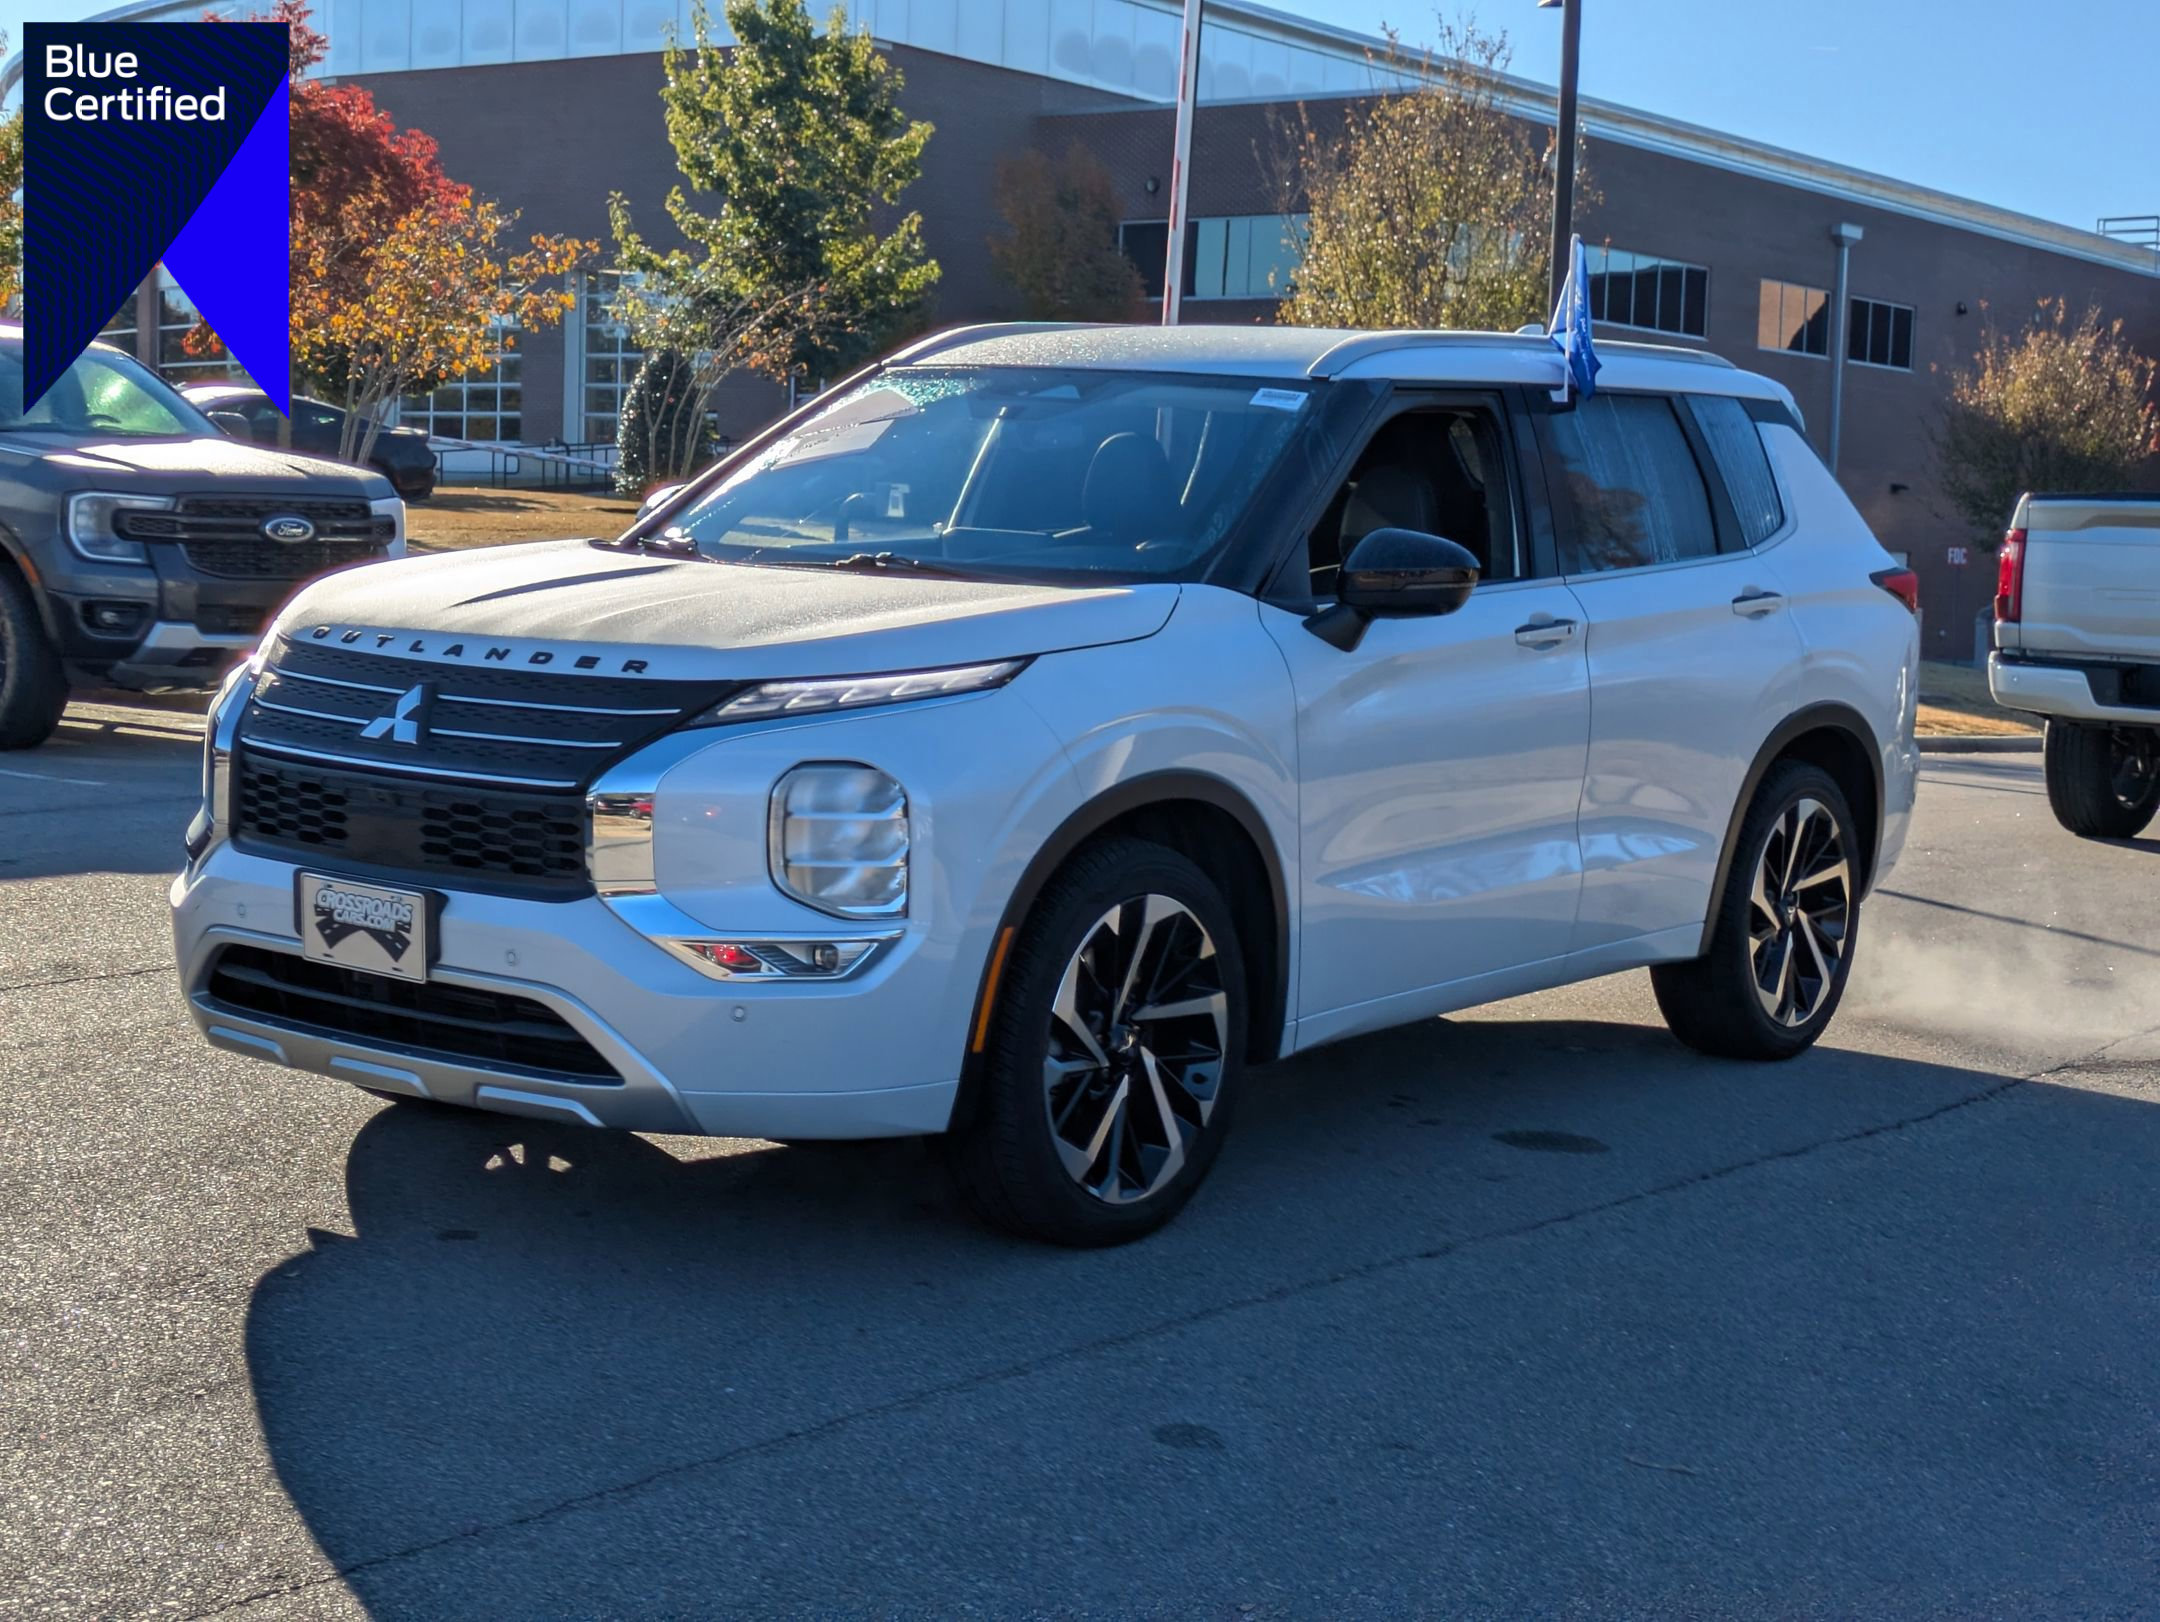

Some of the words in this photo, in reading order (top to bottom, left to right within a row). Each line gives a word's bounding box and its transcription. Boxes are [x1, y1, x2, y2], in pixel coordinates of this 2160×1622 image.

[278, 522, 304, 536] Ford
[1948, 547, 1968, 565] FDC
[312, 626, 649, 674] OUTLANDER
[316, 889, 413, 923] CROSSROADS
